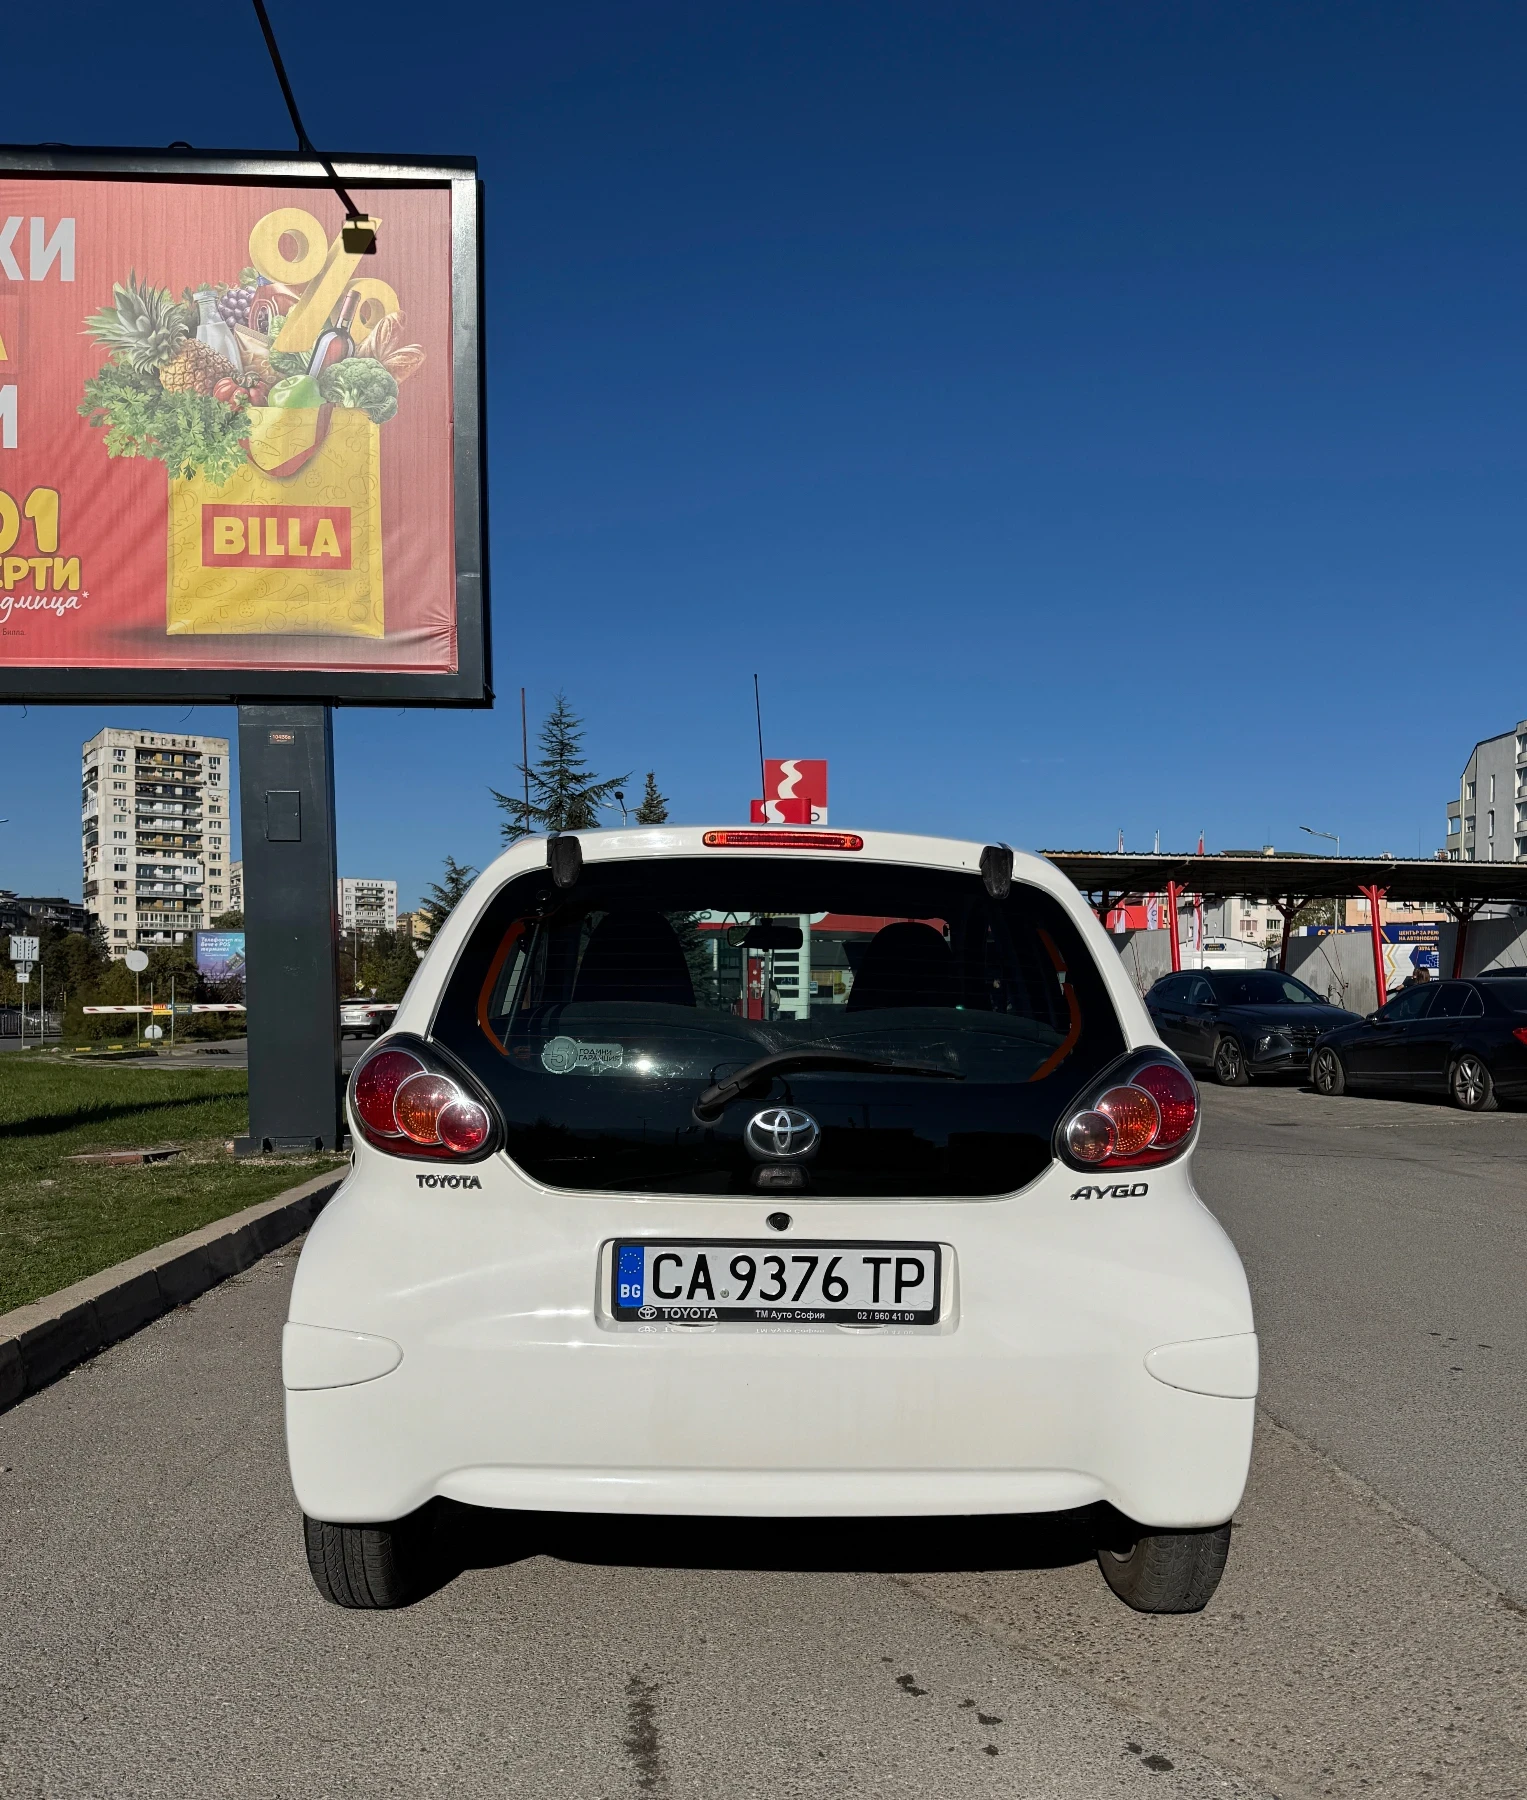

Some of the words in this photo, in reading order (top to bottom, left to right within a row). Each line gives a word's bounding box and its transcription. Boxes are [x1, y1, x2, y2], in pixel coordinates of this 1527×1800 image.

[213, 517, 341, 557] BILLA
[0, 556, 81, 592] РТИ
[578, 1054, 621, 1062] ГАРАНЦИЯ
[415, 1174, 482, 1190] TOYOTA
[1070, 1182, 1149, 1201] AYGO
[652, 1253, 715, 1301] CA
[729, 1254, 850, 1303] 9376
[863, 1257, 926, 1304] TP
[620, 1283, 641, 1299] BG
[662, 1307, 718, 1319] TOYOTA
[770, 1310, 793, 1320] Ауто
[794, 1310, 826, 1320] София
[857, 1311, 868, 1320] 02
[874, 1312, 890, 1321] 960
[891, 1312, 902, 1321] 41
[904, 1313, 915, 1321] 00
